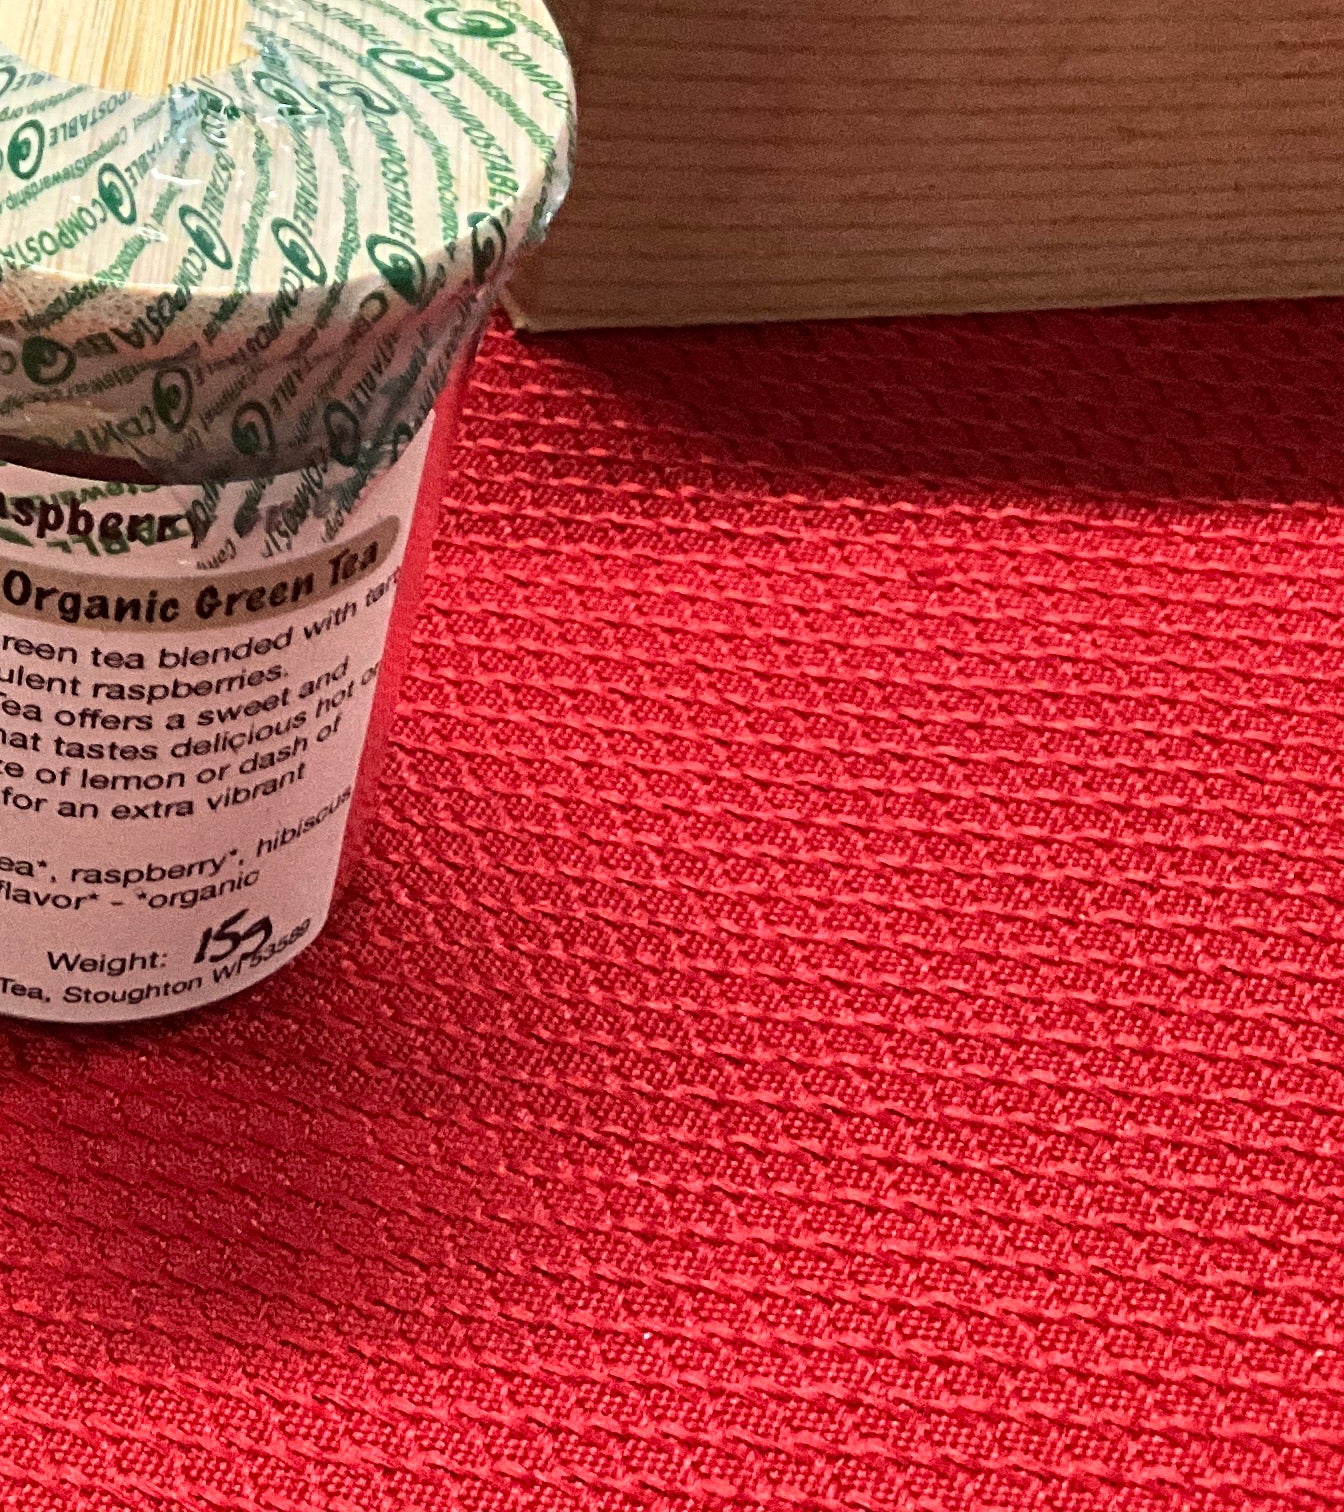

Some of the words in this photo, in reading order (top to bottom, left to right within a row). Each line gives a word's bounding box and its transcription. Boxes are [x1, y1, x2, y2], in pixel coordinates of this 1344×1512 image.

[2, 569, 180, 624] Organic
[196, 570, 315, 619] Green
[330, 540, 380, 588] Tea
[91, 645, 144, 669] tea
[158, 626, 294, 669] blended
[303, 601, 357, 640] with
[55, 707, 161, 731] offers
[166, 712, 184, 730] a
[198, 688, 290, 726] sweet
[299, 656, 350, 700] and
[35, 766, 71, 786] of
[82, 768, 185, 790] lemon
[196, 764, 231, 785] or
[239, 735, 308, 775] dash
[316, 712, 342, 743] of
[54, 736, 158, 761] tastes
[2, 786, 47, 812] for
[57, 799, 99, 819] an
[112, 798, 194, 820] extra
[207, 762, 306, 812] vibrant
[47, 951, 167, 977] Weight:
[63, 976, 202, 1005] Stoughton
